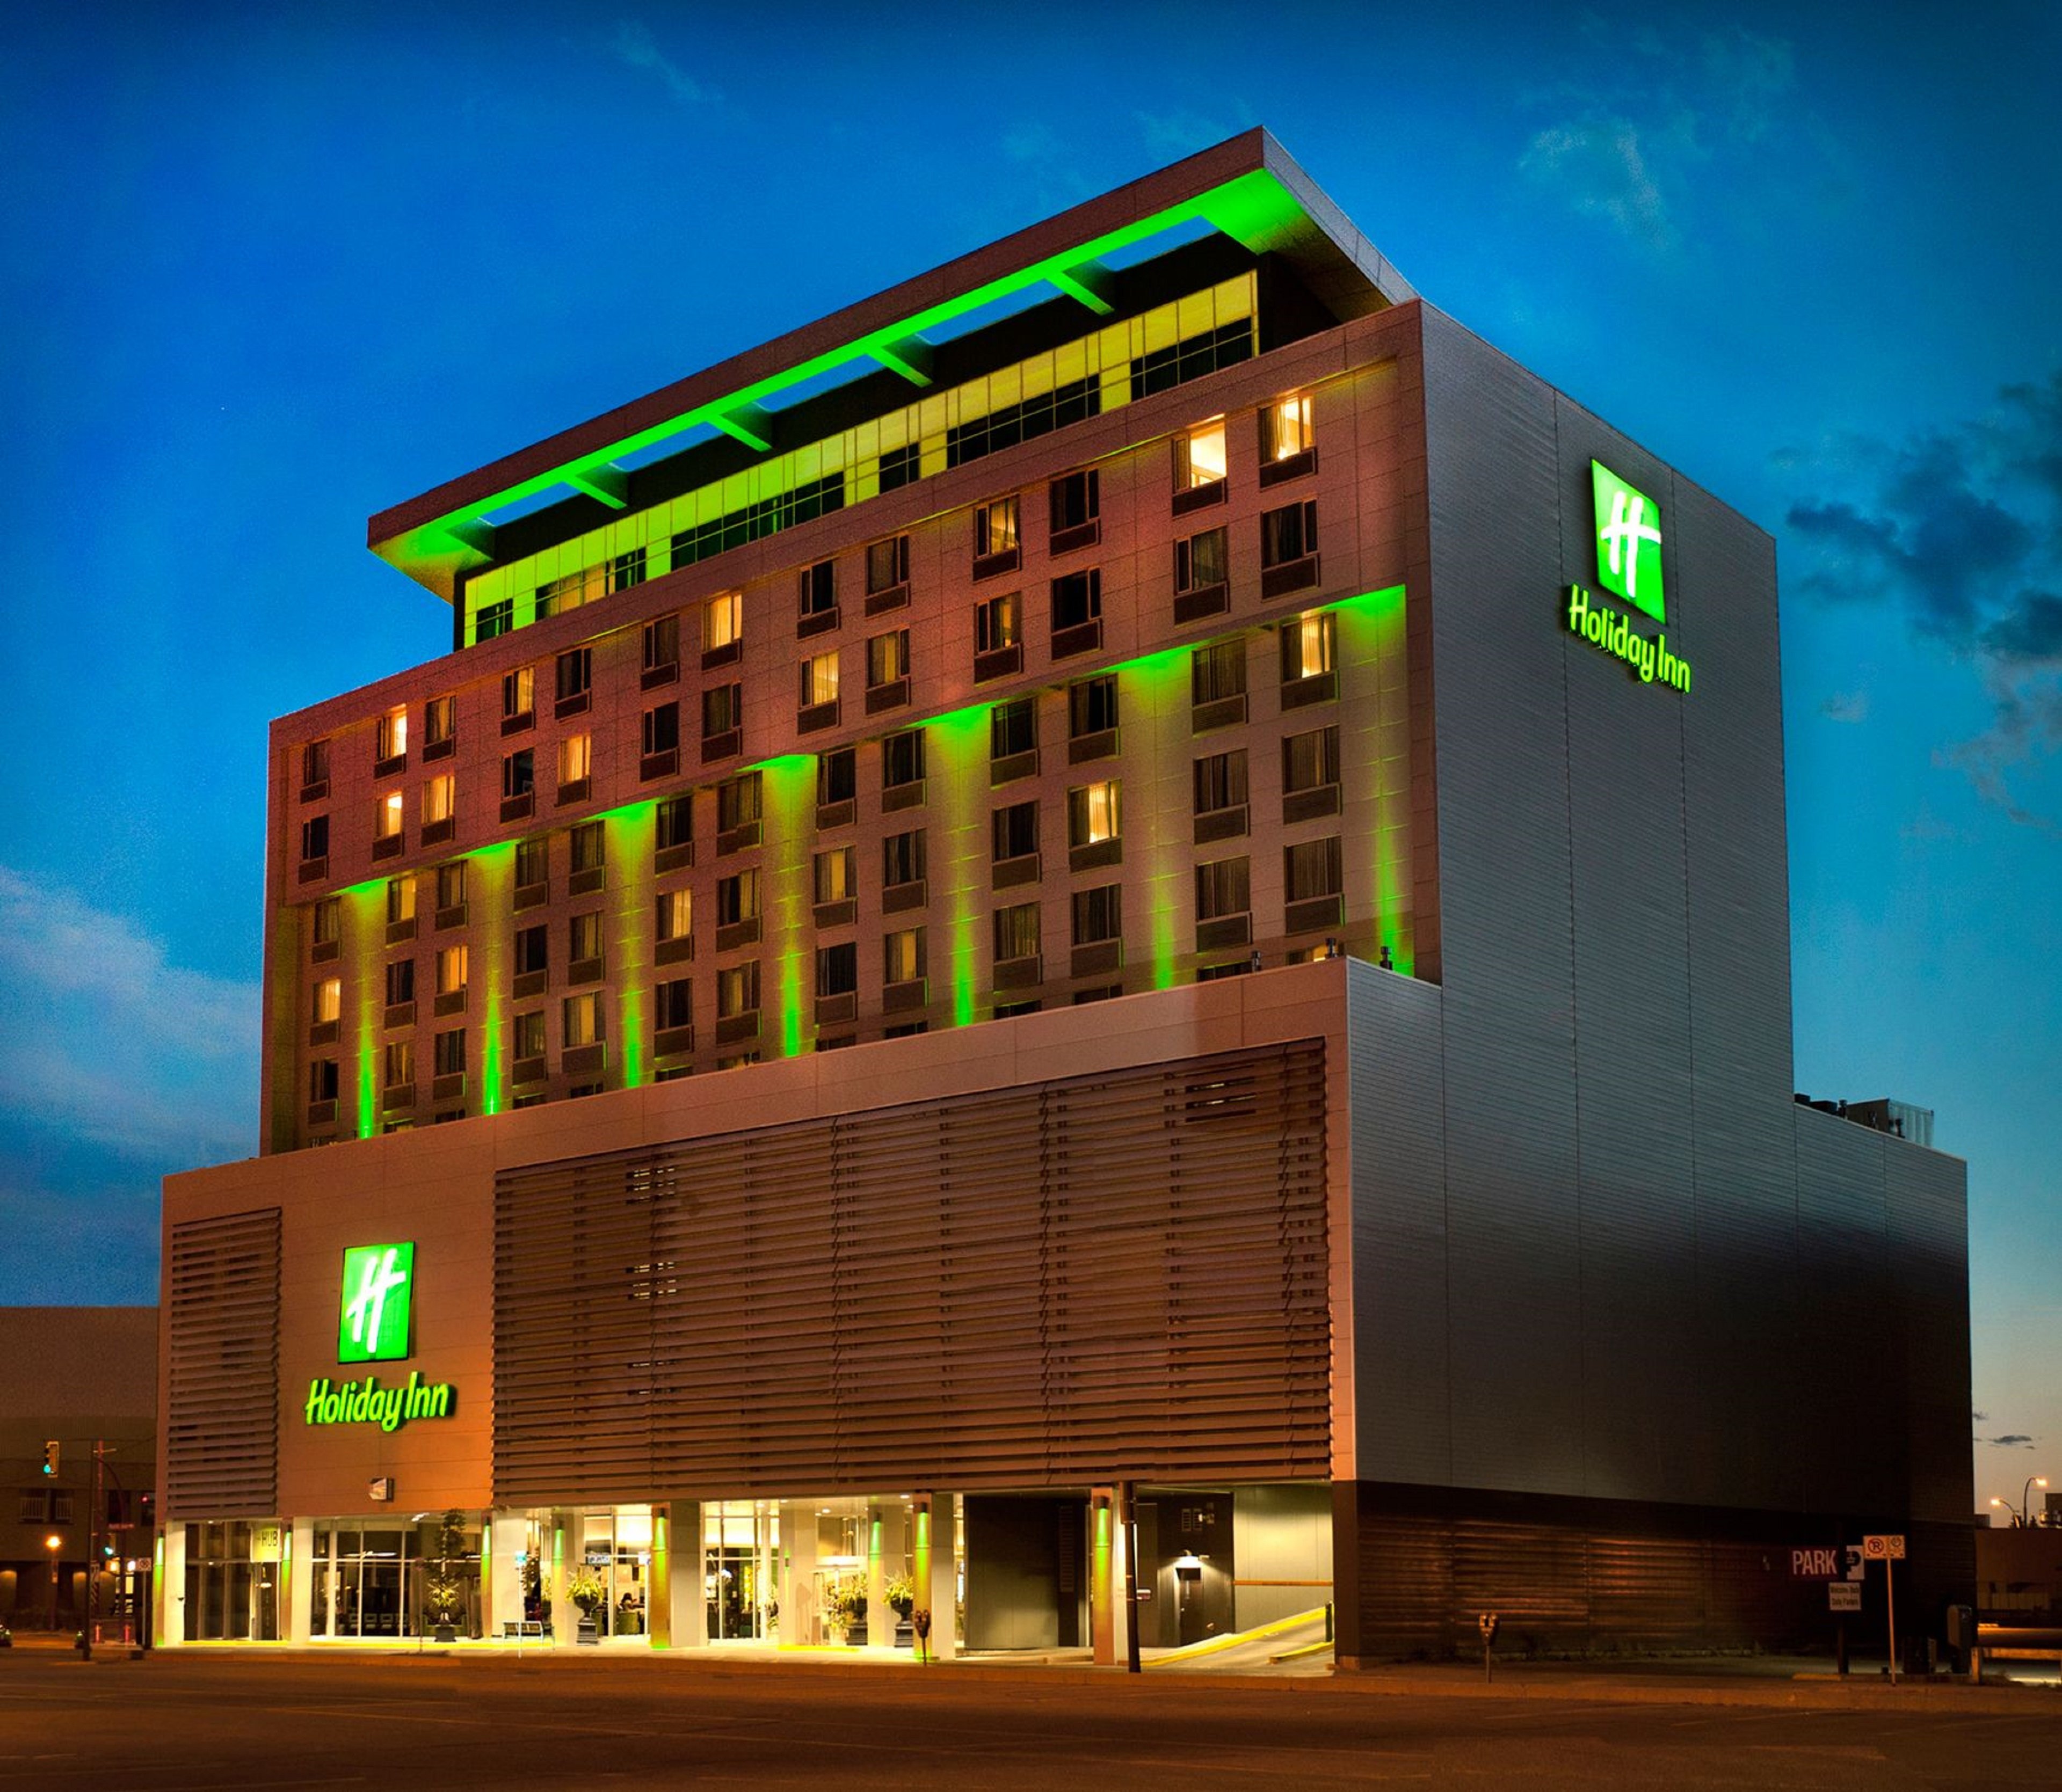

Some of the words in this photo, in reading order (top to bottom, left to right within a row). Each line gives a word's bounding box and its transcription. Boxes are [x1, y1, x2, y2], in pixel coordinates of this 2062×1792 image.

[1569, 584, 1655, 683] Holiday
[1658, 633, 1691, 693] Inn
[305, 1376, 403, 1432] Holiday
[404, 1371, 449, 1419] Inn
[262, 1531, 278, 1547] HUB
[1792, 1550, 1838, 1575] PARK
